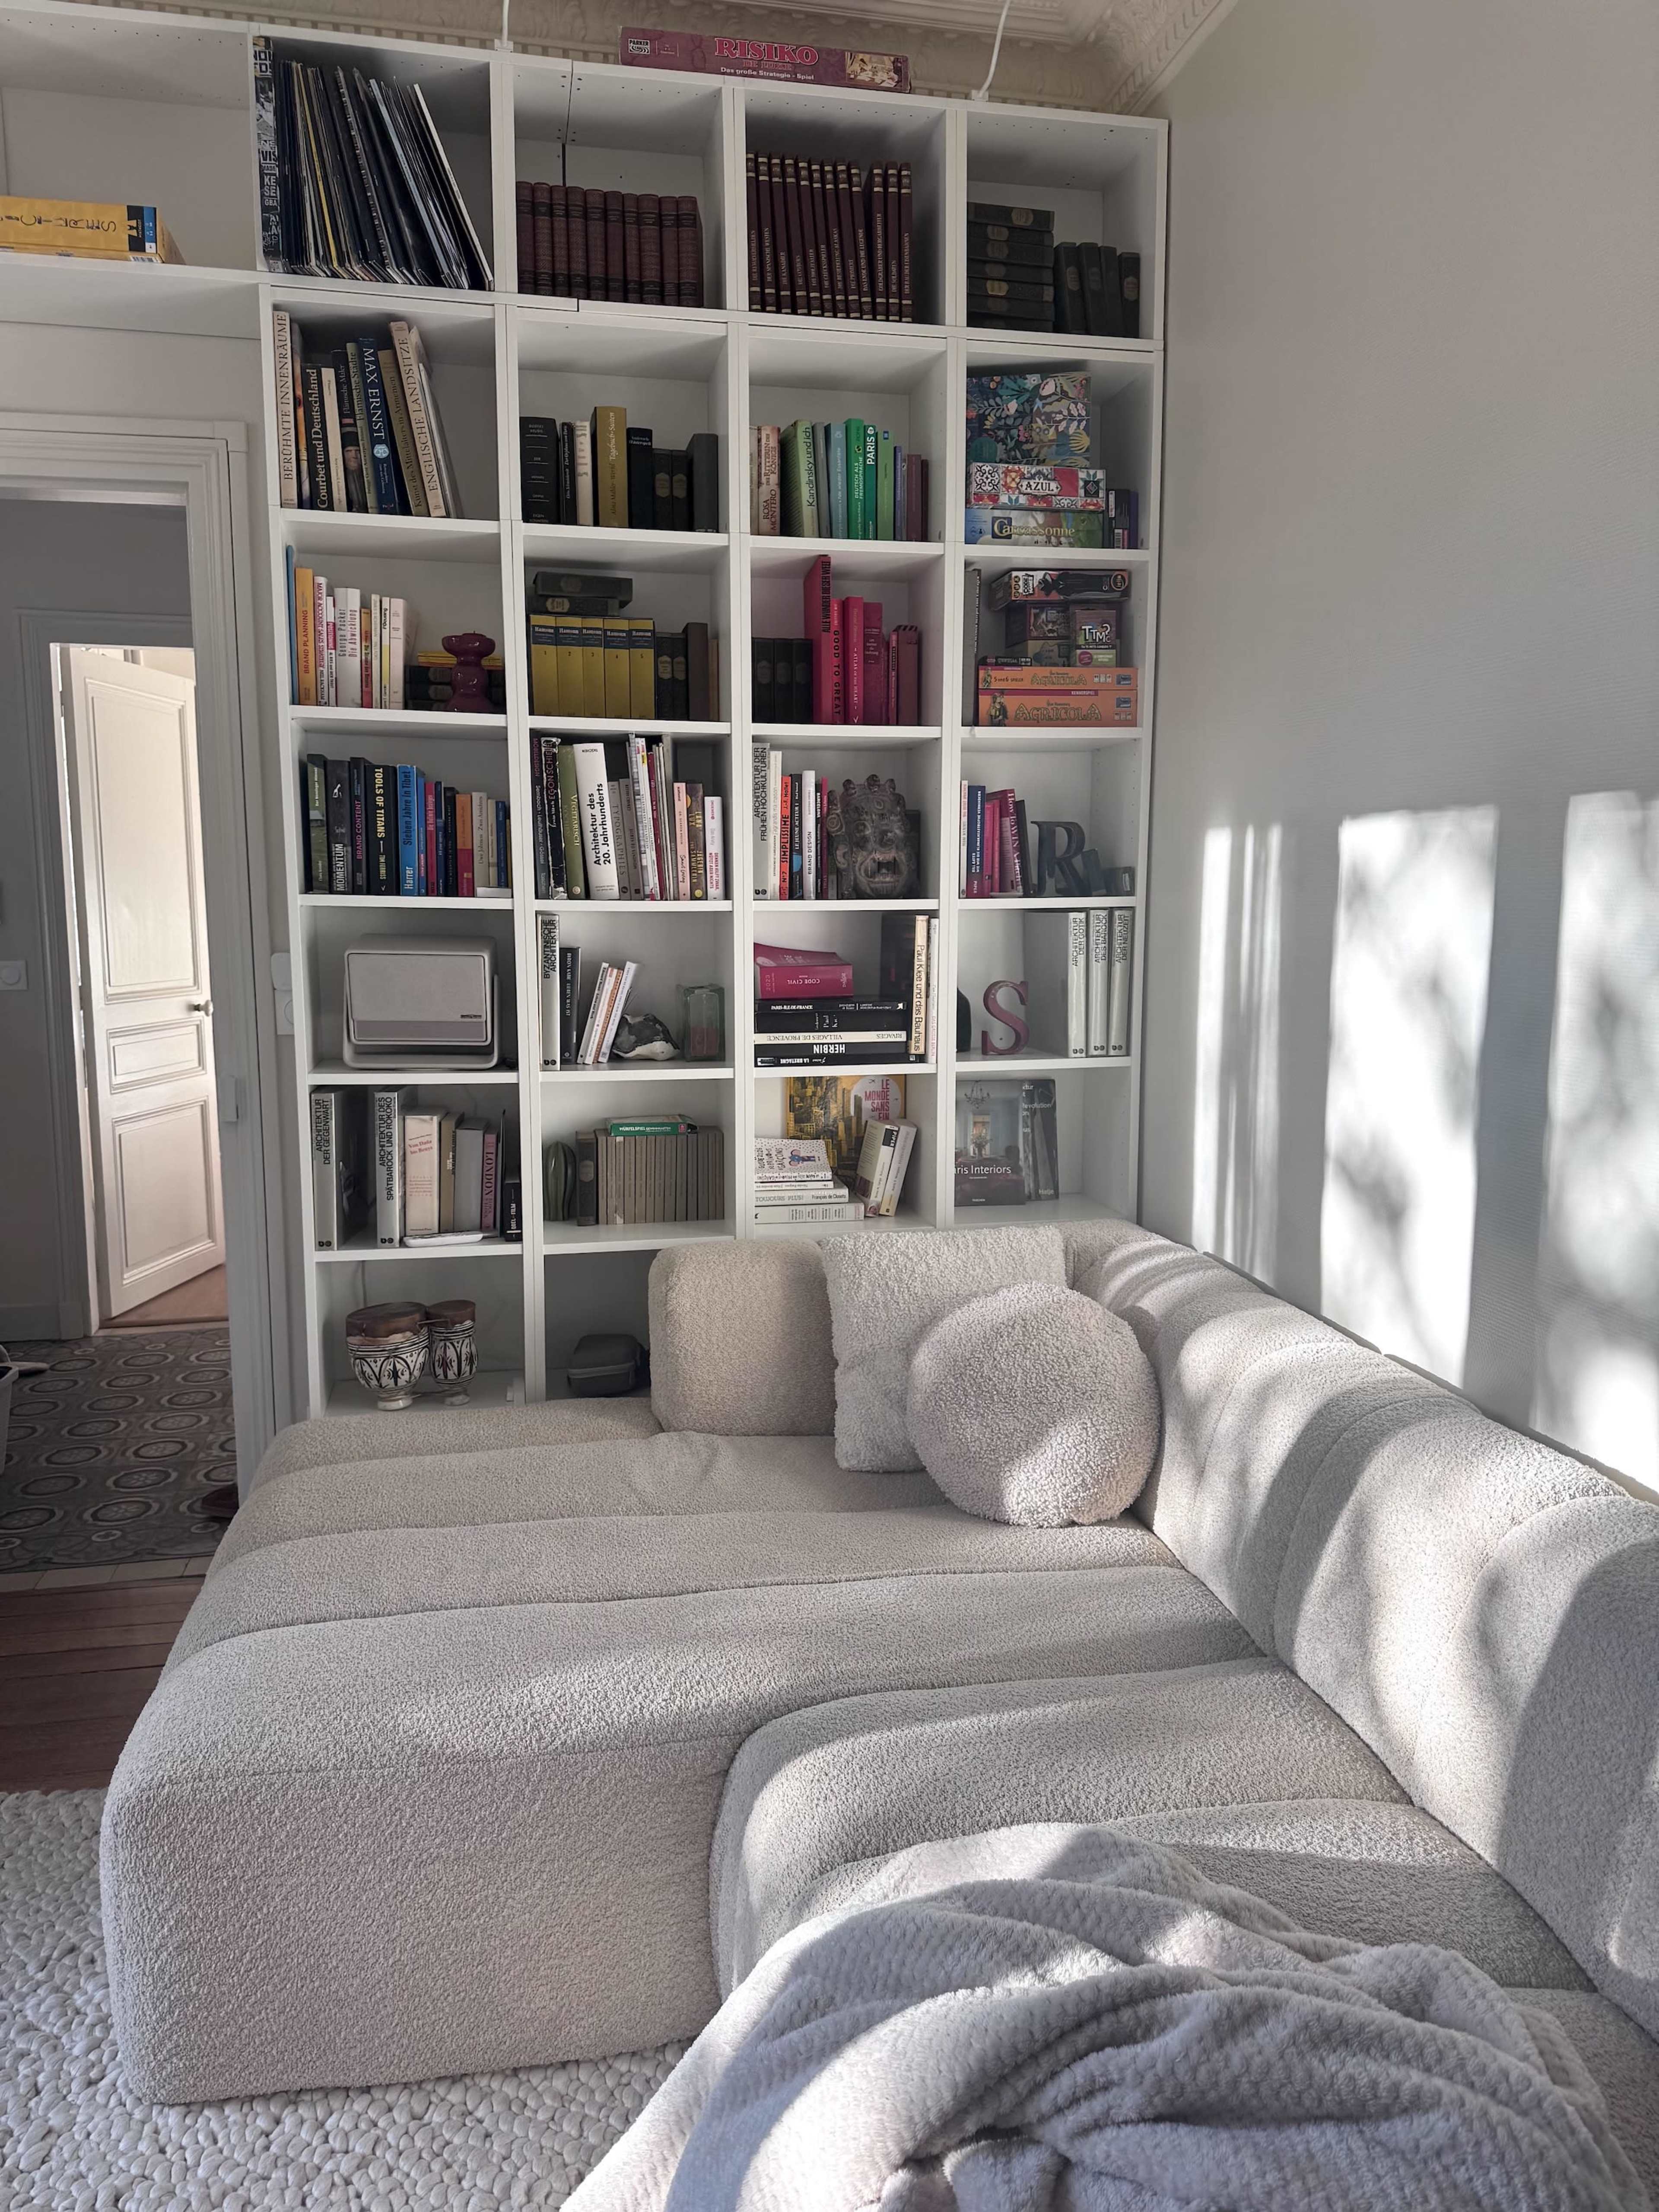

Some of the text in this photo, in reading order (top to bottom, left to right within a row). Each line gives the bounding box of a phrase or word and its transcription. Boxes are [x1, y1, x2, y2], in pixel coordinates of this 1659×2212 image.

[715, 38, 819, 65] RISIKO
[276, 314, 293, 480] BERÜHMTE INNENRÄUME
[362, 347, 385, 439] MAX ERNST
[390, 376, 403, 414] Armenien
[398, 338, 438, 491] ENGLISCHE LANDSITZE
[306, 369, 328, 508] Courbet und Deutschland
[867, 436, 875, 465] PARIS
[801, 426, 815, 507] Kandinsky und ich
[1025, 481, 1054, 492] AZUL
[411, 484, 423, 507] Kunst
[994, 519, 1075, 537] Carcassonne
[338, 608, 347, 657] George Packer
[834, 663, 840, 676] TO
[401, 771, 411, 789] Tibet
[375, 768, 385, 838] TOOLS OF TITANS
[402, 800, 412, 820] Jahre
[570, 794, 580, 846] VEGETARISCH
[596, 783, 610, 847] Jahrhunderts
[403, 821, 413, 845] Sieben
[587, 793, 601, 866] Architektur des
[611, 803, 625, 875] TYPOGRAPHIES
[335, 843, 345, 891] MOMENTUM
[404, 866, 413, 889] Harrer
[814, 1044, 845, 1053] HERBIN
[914, 1017, 922, 1051] Bauhaus
[864, 1090, 890, 1101] MONDE
[881, 1079, 890, 1089] LE
[314, 1099, 323, 1152] ARCHITEKTUR
[871, 1101, 890, 1112] SANS
[322, 1099, 331, 1165] DER GEGENWART
[385, 1149, 394, 1201] SPÄTBAROCK
[485, 1152, 494, 1196] LONDON
